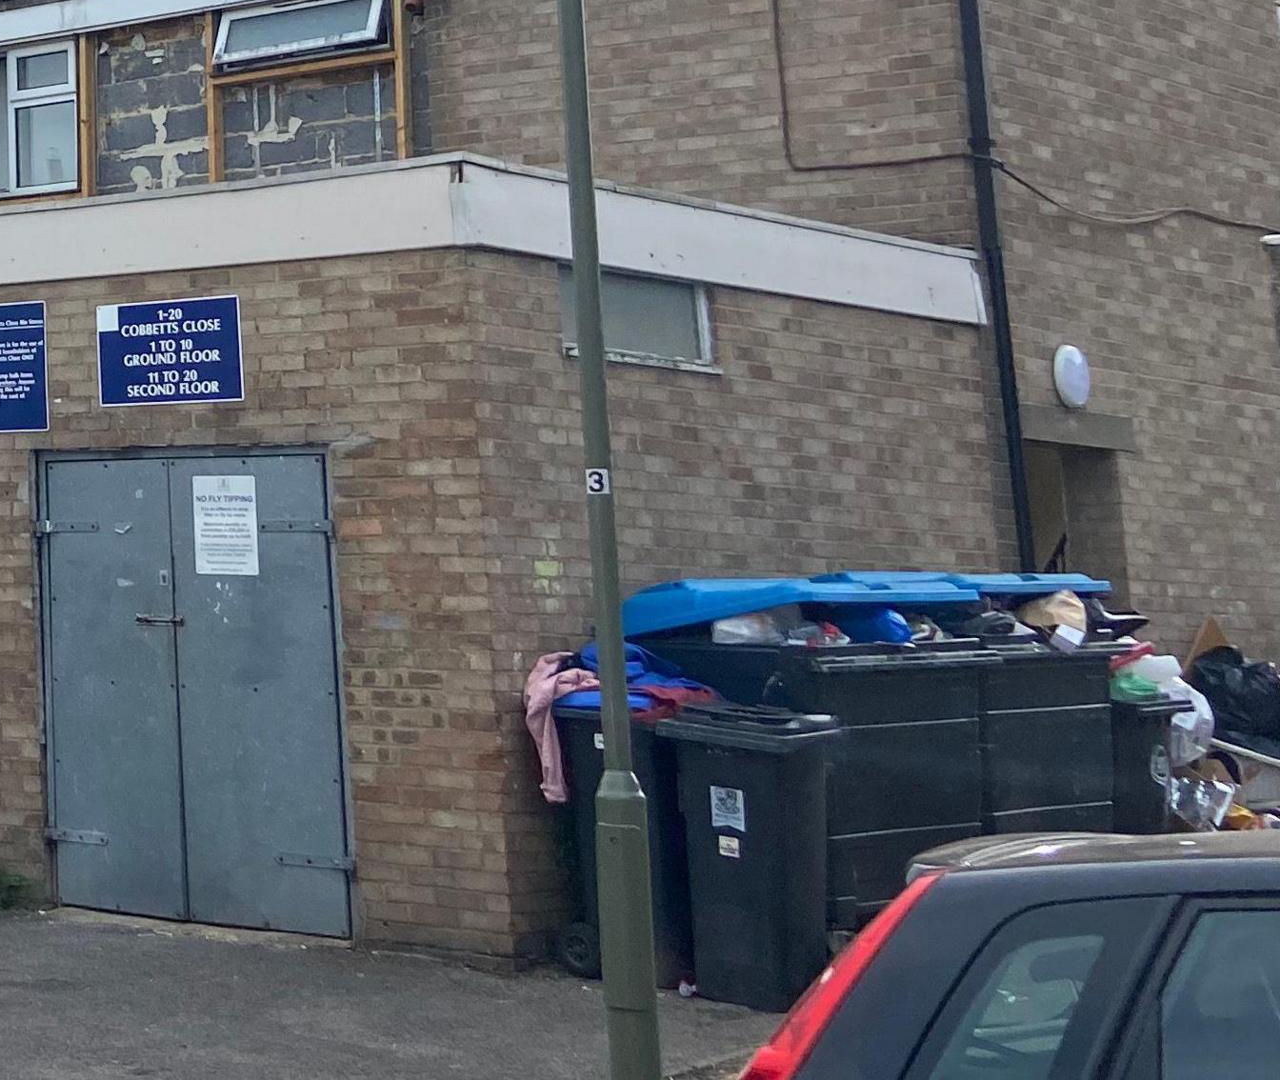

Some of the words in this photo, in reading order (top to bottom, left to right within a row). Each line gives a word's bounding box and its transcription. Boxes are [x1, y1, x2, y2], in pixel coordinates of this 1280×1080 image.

[157, 308, 182, 320] 1-20
[121, 322, 179, 337] COBBETTS
[183, 318, 221, 333] CLOSE
[149, 341, 156, 352] 1
[159, 339, 176, 352] TO
[180, 338, 193, 350] 10
[124, 352, 176, 366] GROUND
[180, 349, 220, 363] FLOOR
[147, 372, 159, 383] 11
[162, 370, 179, 382] TO
[183, 369, 198, 381] 20
[127, 383, 176, 397] SECOND
[180, 380, 220, 394] FLOOR
[589, 471, 604, 492] 3
